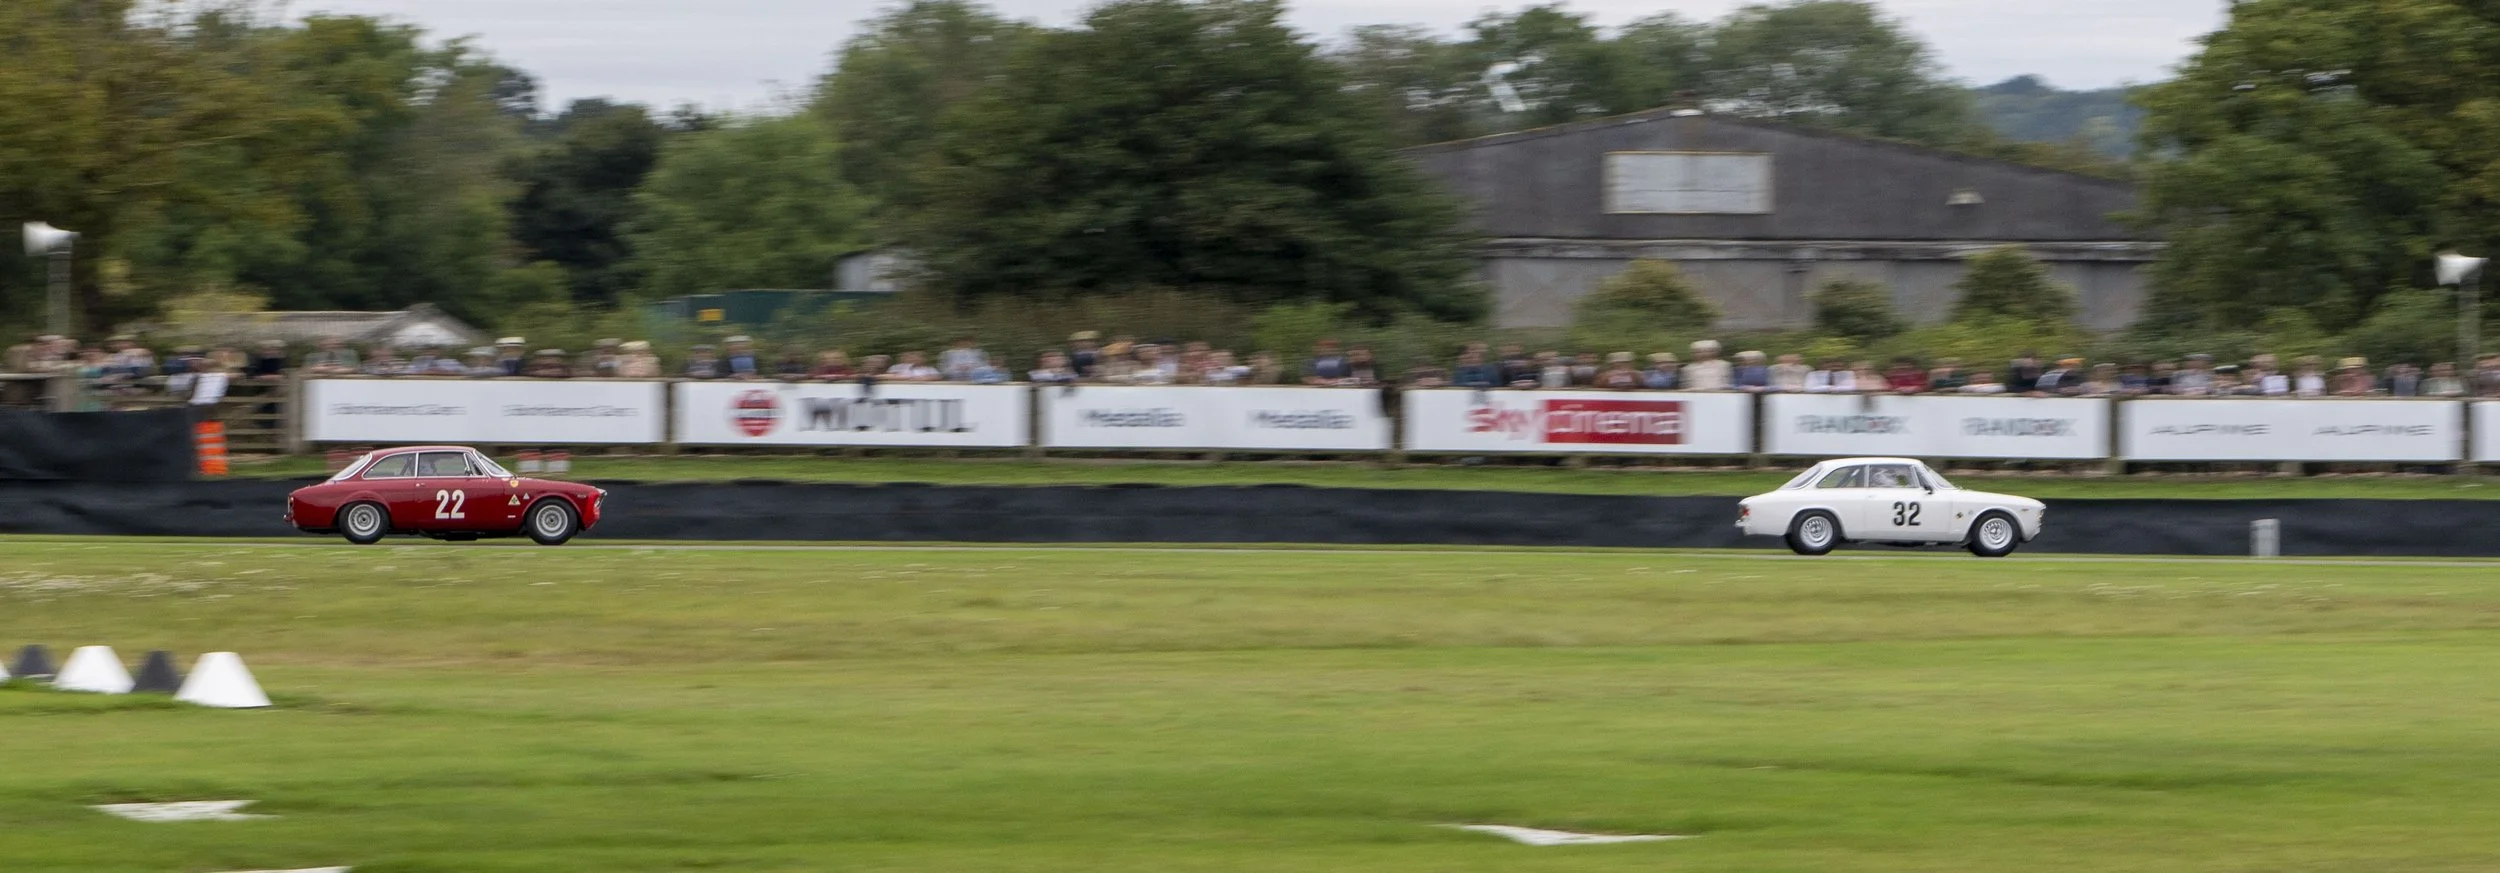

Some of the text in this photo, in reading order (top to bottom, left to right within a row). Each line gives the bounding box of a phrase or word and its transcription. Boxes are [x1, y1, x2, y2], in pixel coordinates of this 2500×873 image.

[799, 398, 975, 432] MOTUL
[1545, 403, 1685, 434] cinema
[435, 489, 465, 520] 22
[1893, 501, 1921, 526] 32
